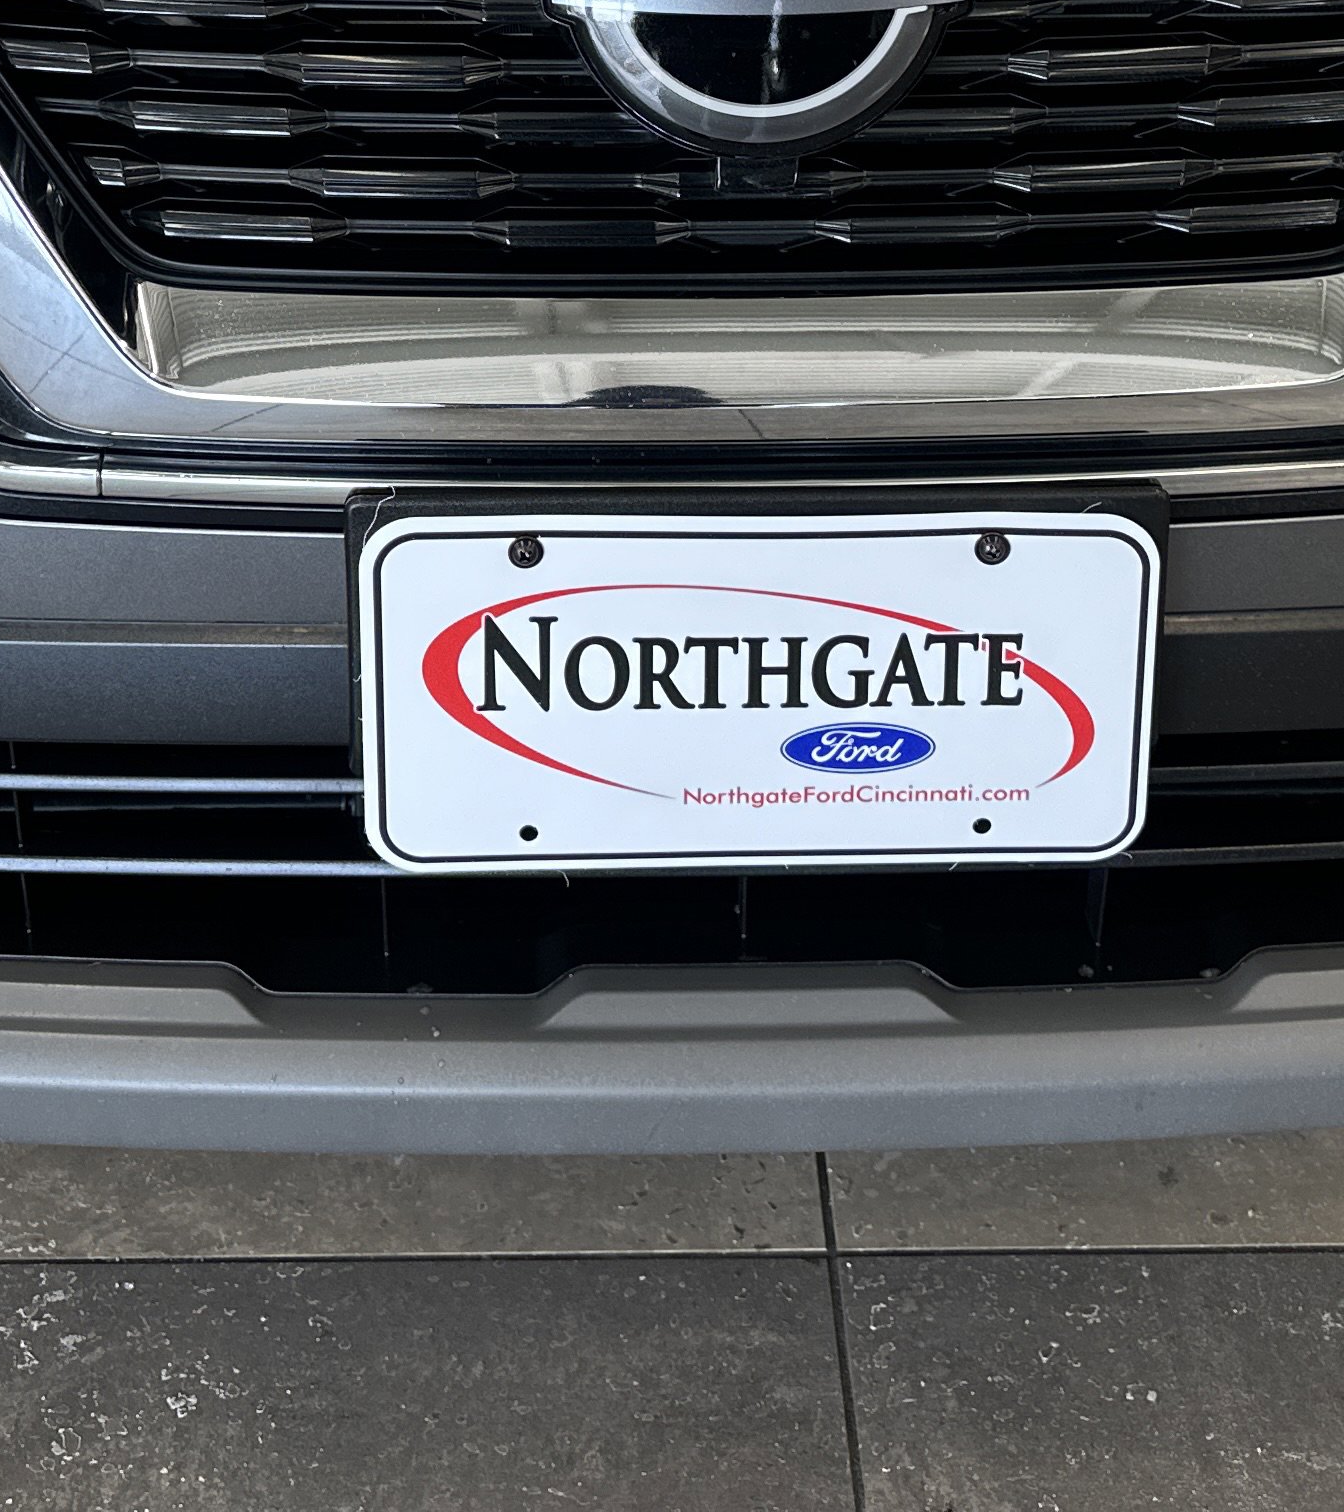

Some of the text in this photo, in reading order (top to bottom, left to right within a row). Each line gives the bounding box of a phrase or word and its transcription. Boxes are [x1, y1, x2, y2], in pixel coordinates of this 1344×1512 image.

[476, 613, 1024, 713] NORTHGATE
[811, 728, 904, 764] Ford
[683, 784, 1030, 809] NorthgateFordCincinnati.com
